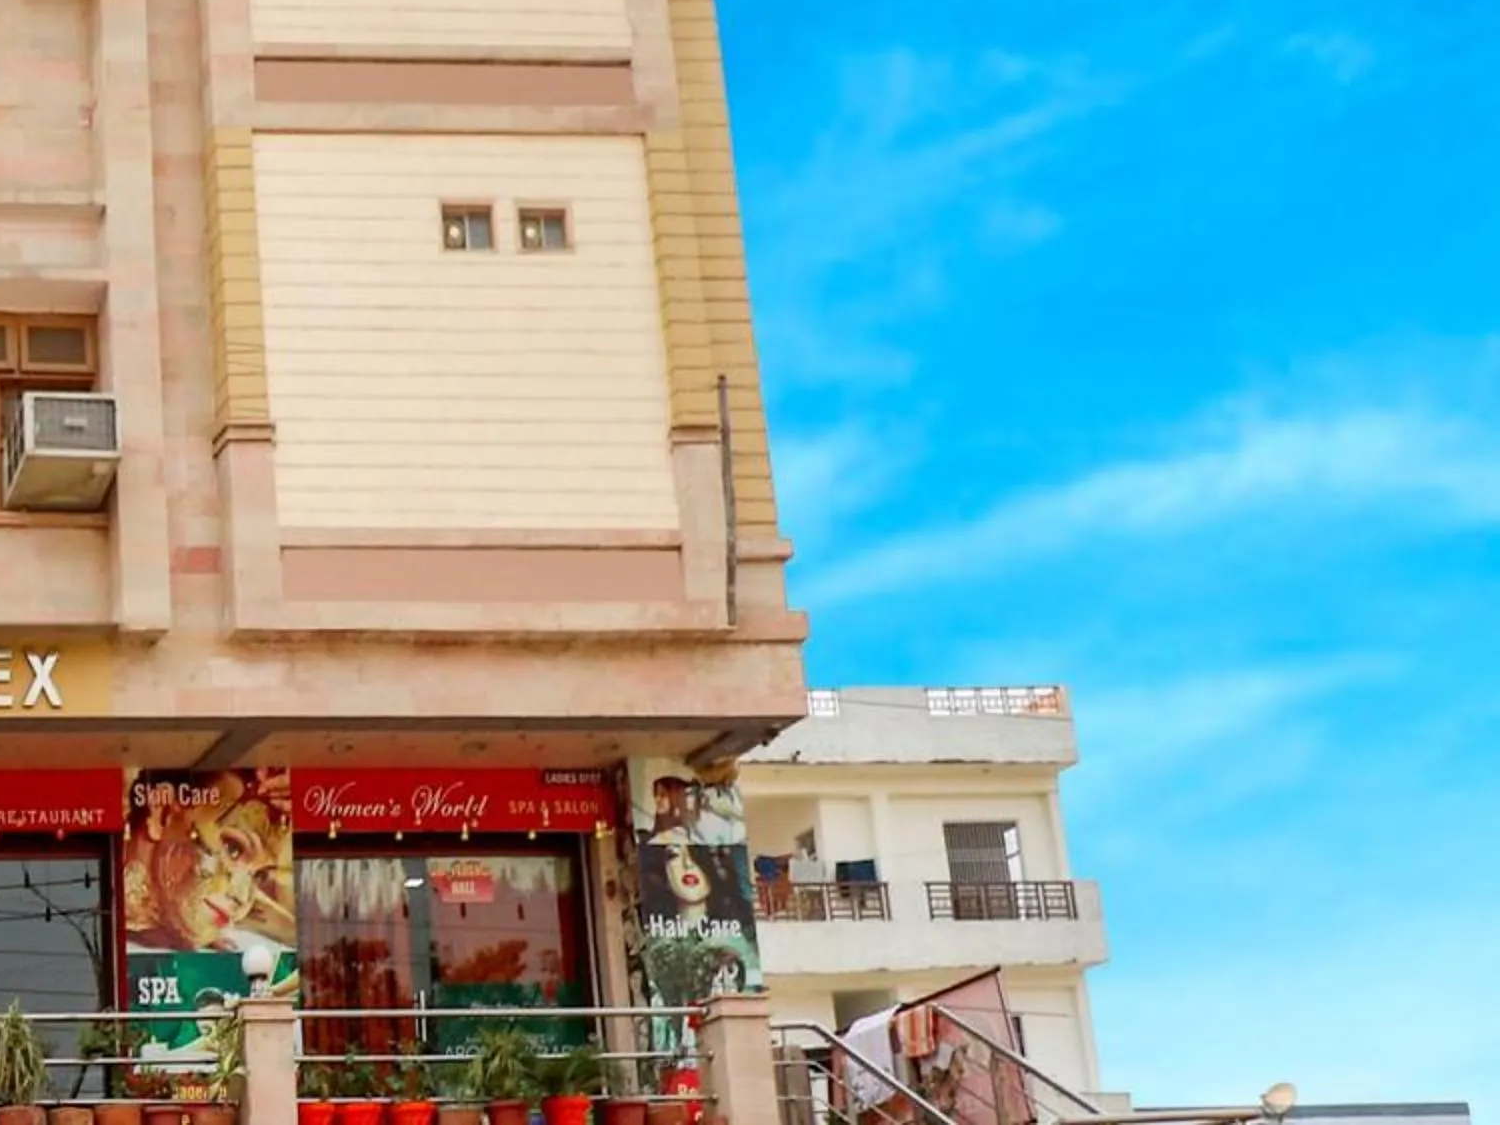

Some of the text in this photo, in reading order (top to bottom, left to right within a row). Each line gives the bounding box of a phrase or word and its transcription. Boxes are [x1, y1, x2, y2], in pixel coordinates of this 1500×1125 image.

[133, 782, 220, 807] Skin Care
[303, 781, 401, 817] Women's
[410, 781, 488, 817] World
[508, 799, 536, 814] SPA
[554, 799, 599, 814] SALON
[649, 913, 742, 938] Hair Care
[138, 977, 182, 1005] SPA
